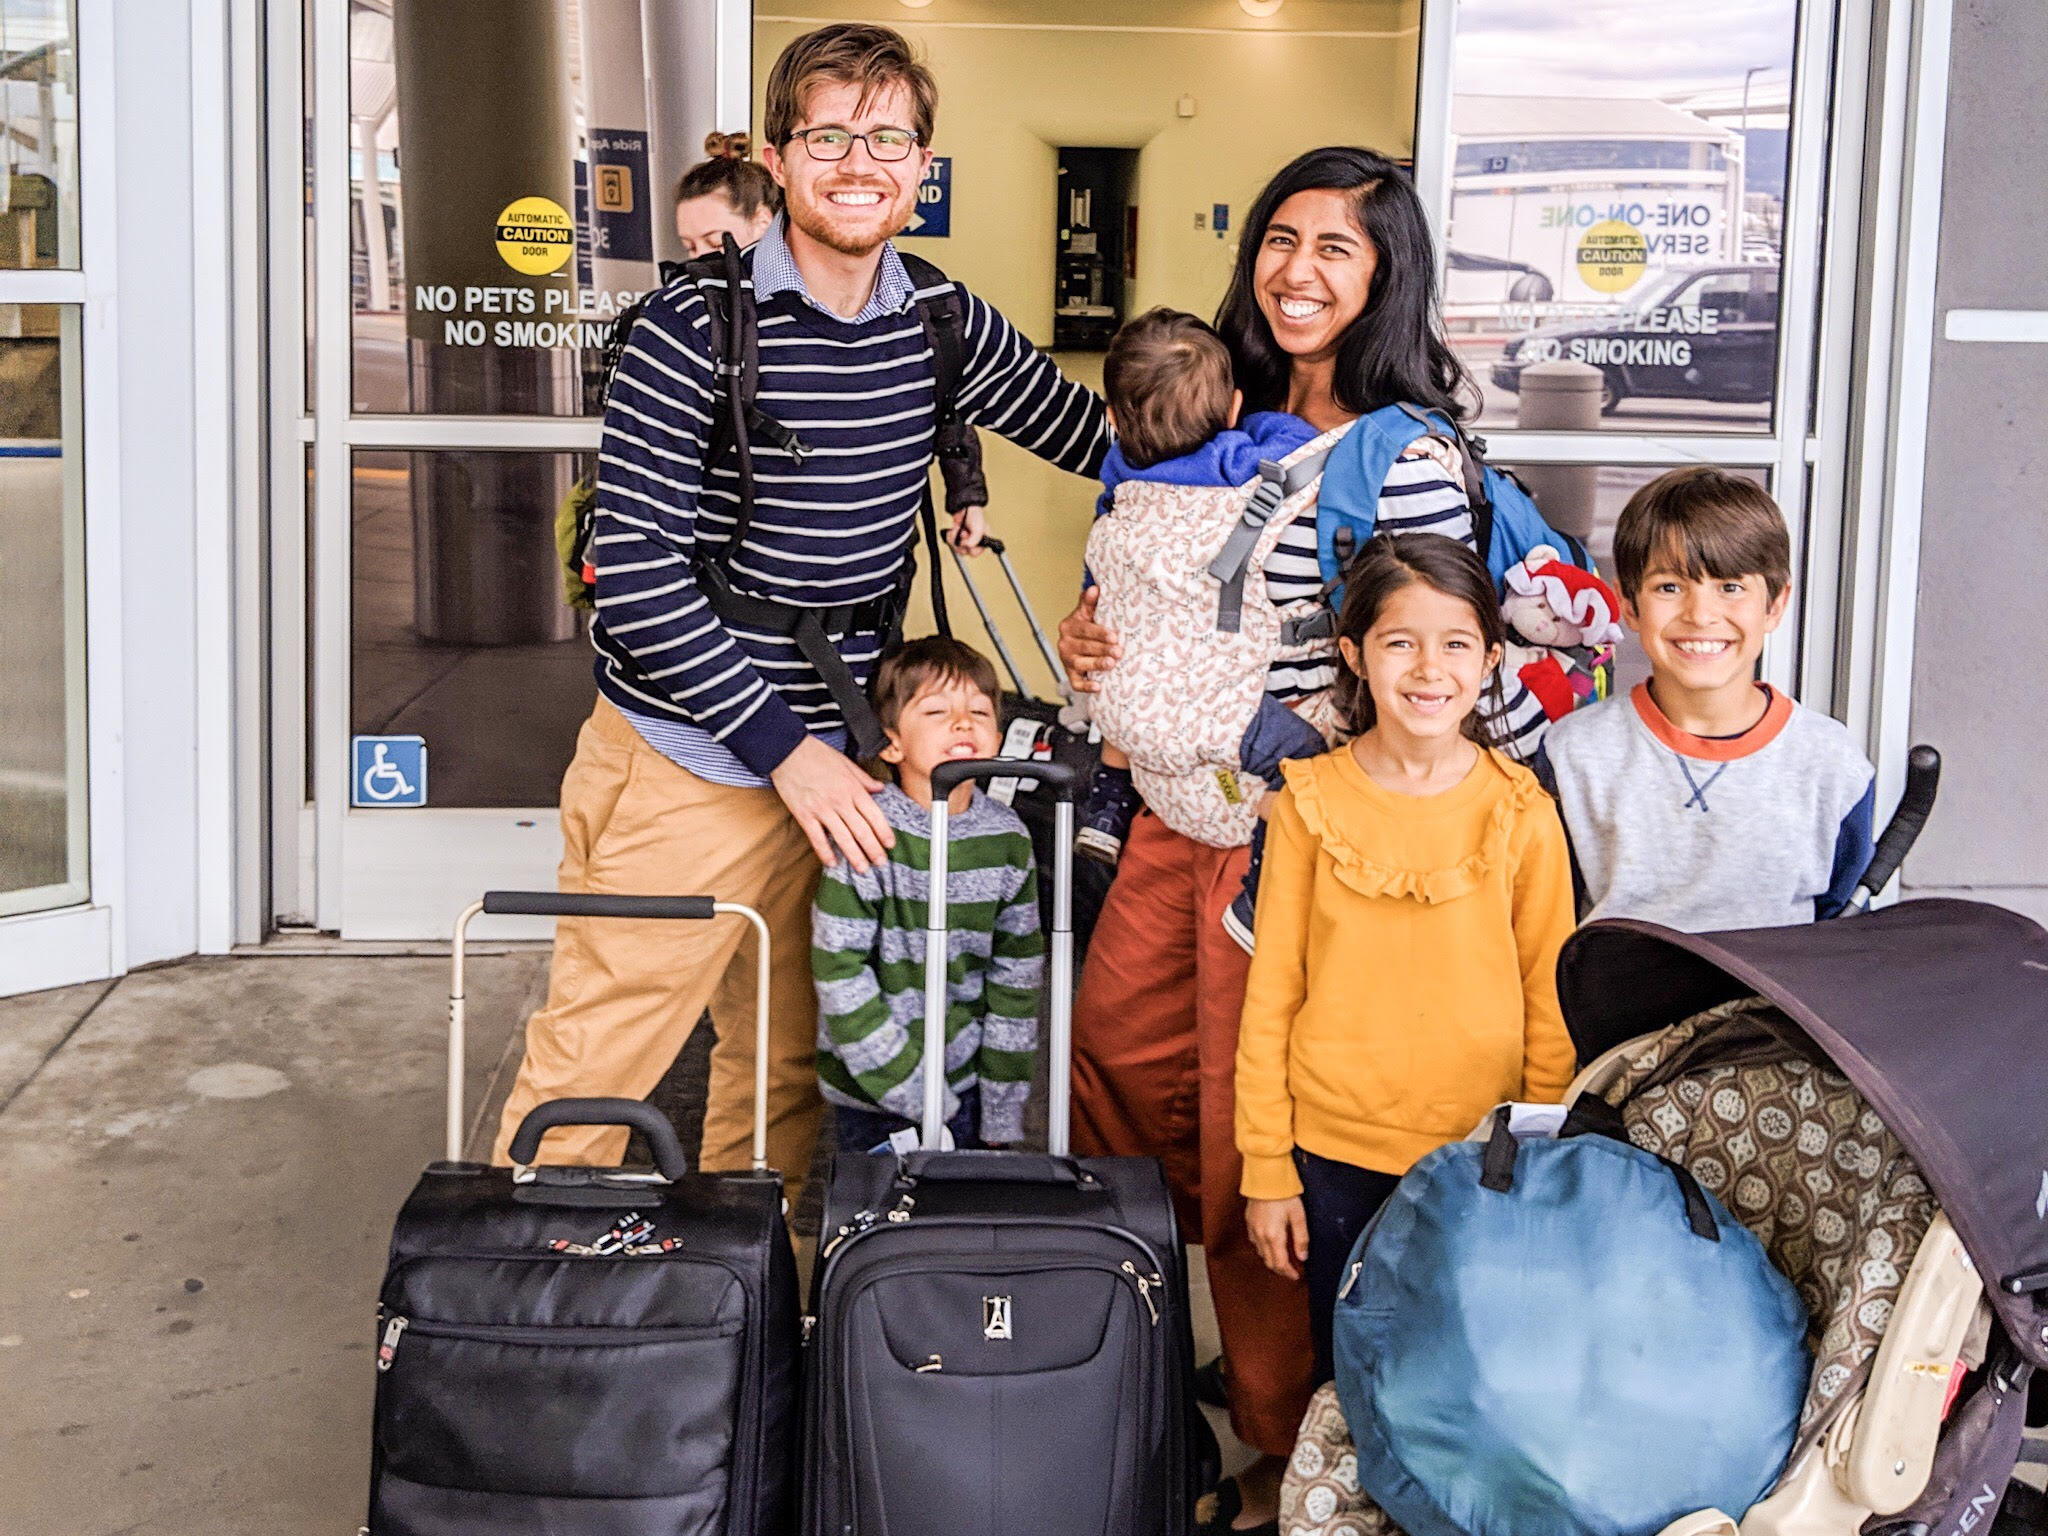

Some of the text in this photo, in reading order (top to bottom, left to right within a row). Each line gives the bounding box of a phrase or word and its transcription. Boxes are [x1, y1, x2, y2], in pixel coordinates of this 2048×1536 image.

[508, 213, 564, 225] AUTOMATIC
[502, 227, 569, 243] CAUTION
[1586, 234, 1639, 246] AUTOMATIC
[522, 246, 549, 257] DOOR
[1582, 249, 1643, 263] CAUTION
[1598, 266, 1624, 277] DOOR
[415, 285, 457, 313] NO
[464, 286, 536, 315] PETS
[1499, 305, 1536, 331] NO
[1617, 306, 1720, 335] PLEASE
[444, 319, 487, 347] NO
[1568, 338, 1692, 367] SMOKING
[1950, 1483, 1997, 1536] EN
